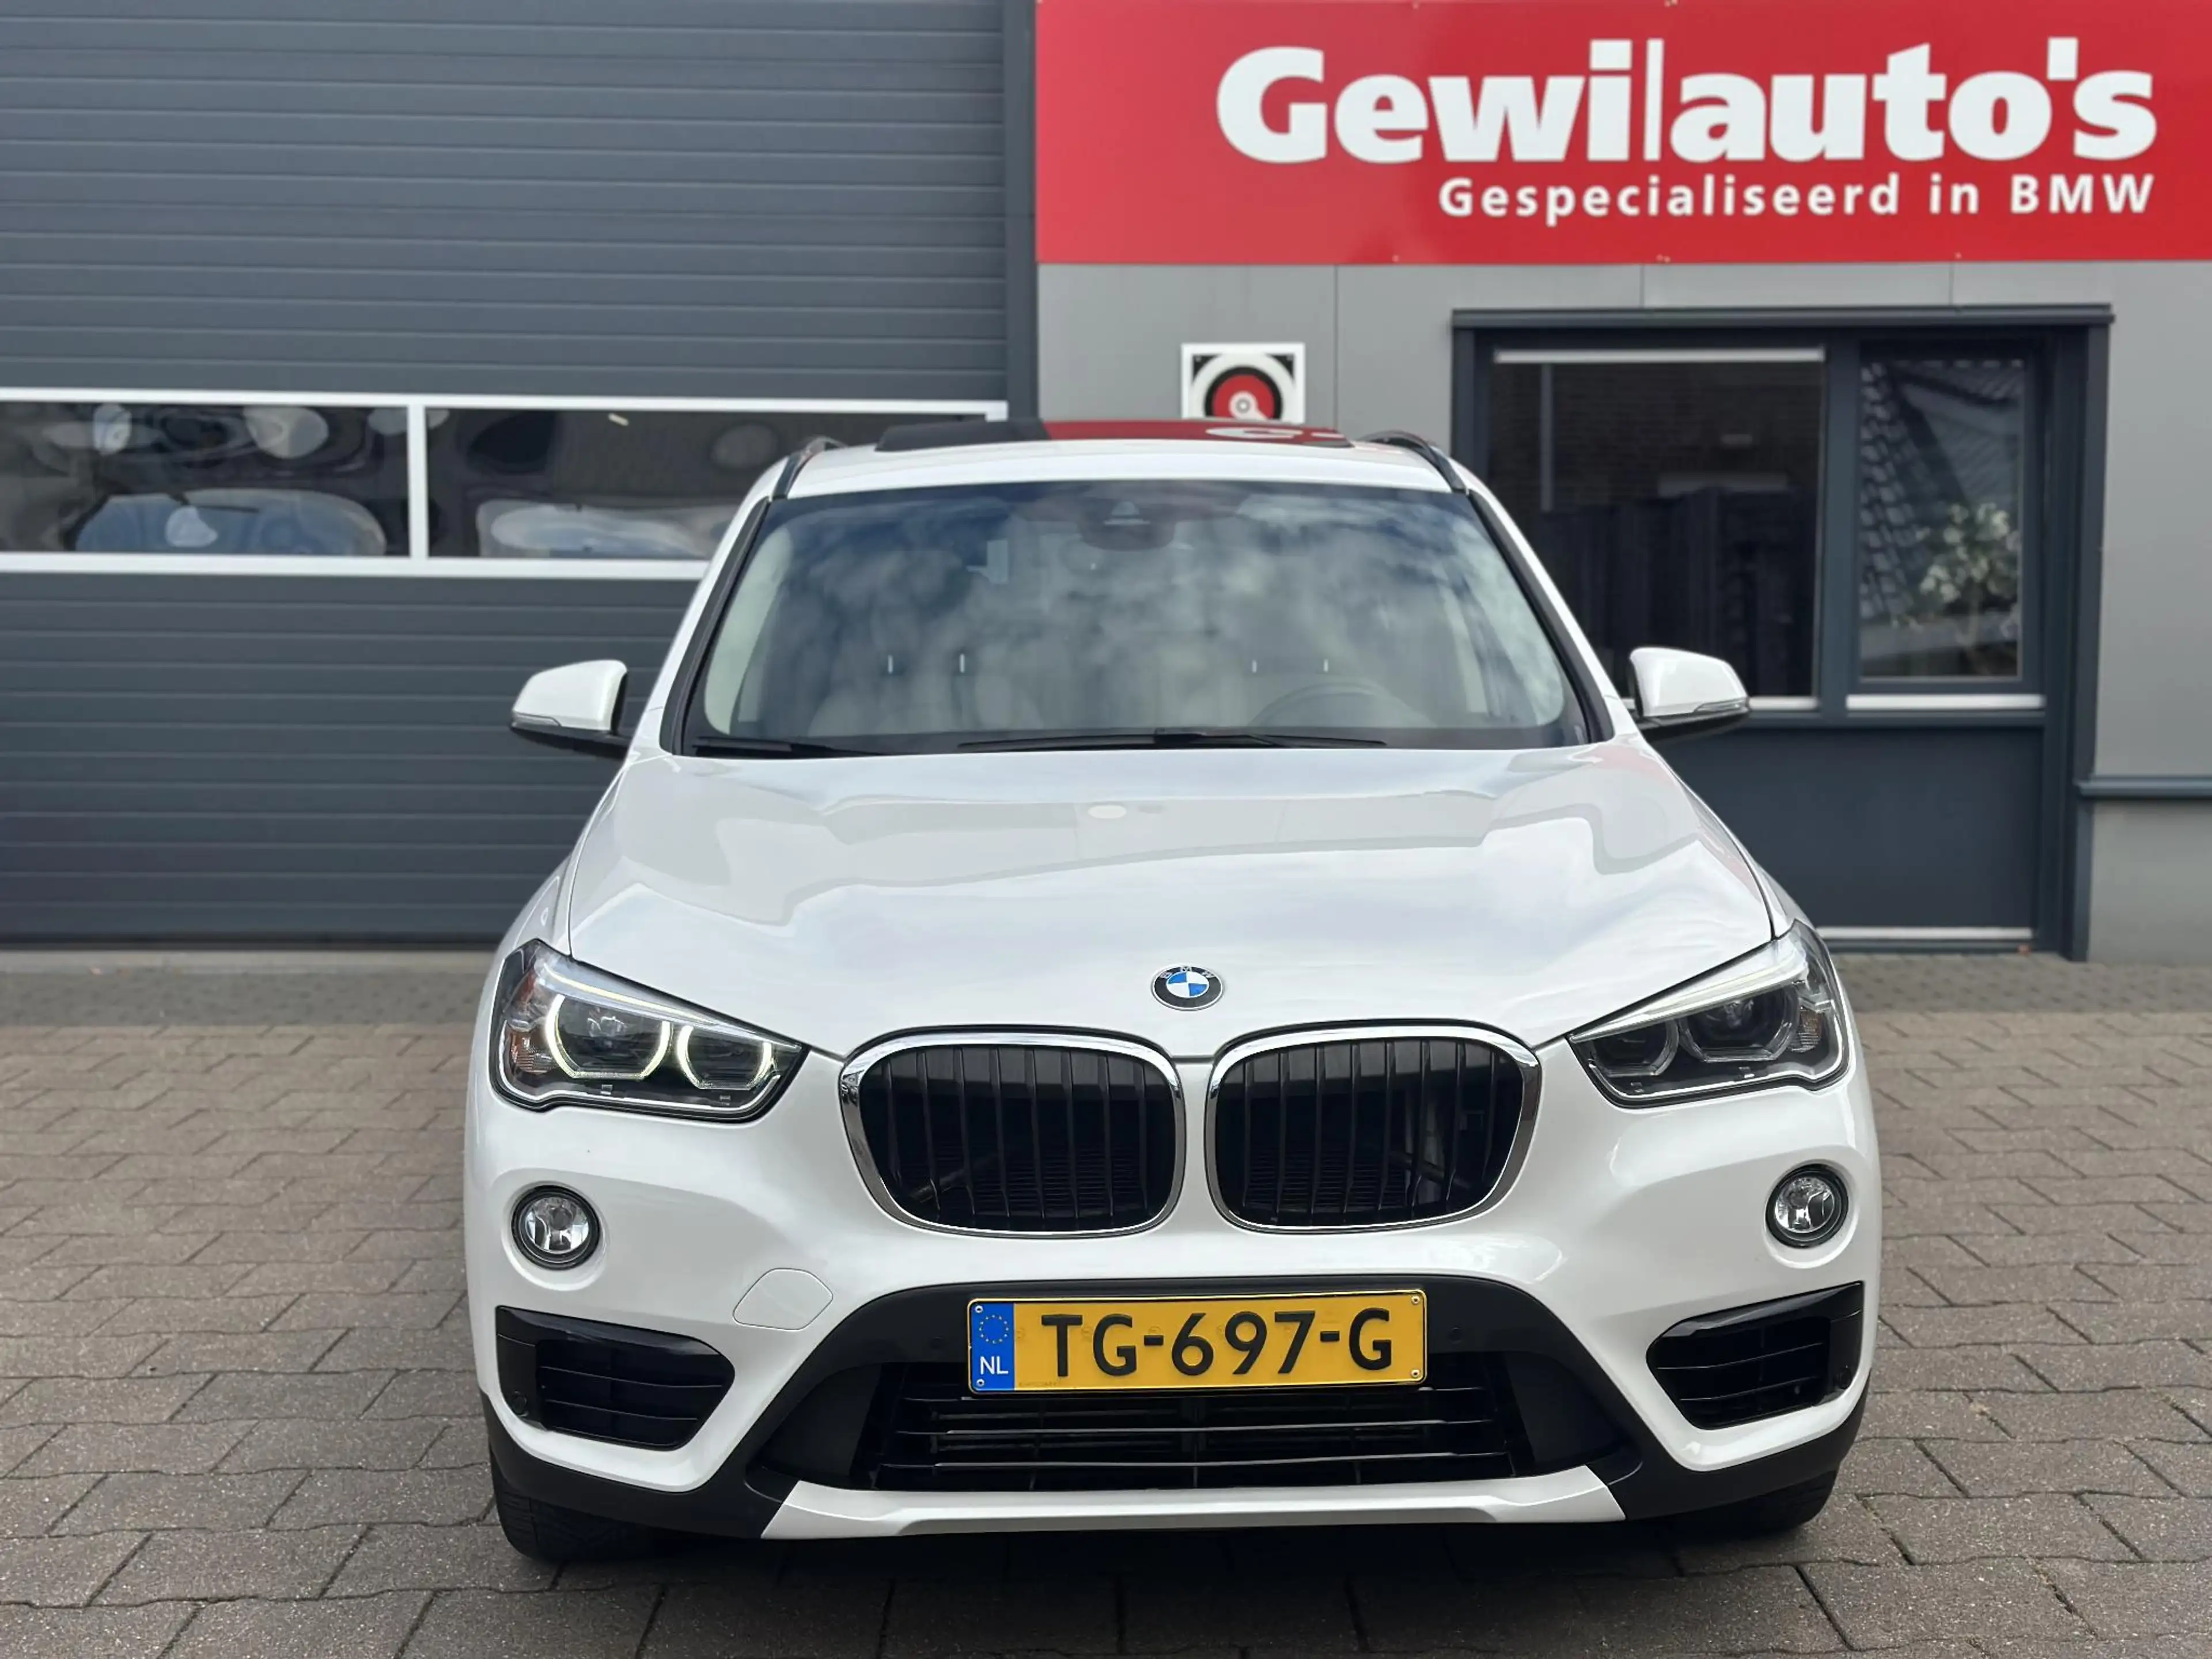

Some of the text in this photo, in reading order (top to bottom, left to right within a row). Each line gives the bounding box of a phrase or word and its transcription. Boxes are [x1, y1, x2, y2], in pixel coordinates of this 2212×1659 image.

[1215, 37, 2157, 165] Gewilauto's
[1438, 172, 2154, 228] Gespecialiseerd in BMW
[979, 1355, 1009, 1375] NL
[1040, 1307, 1393, 1377] TG-697-G
